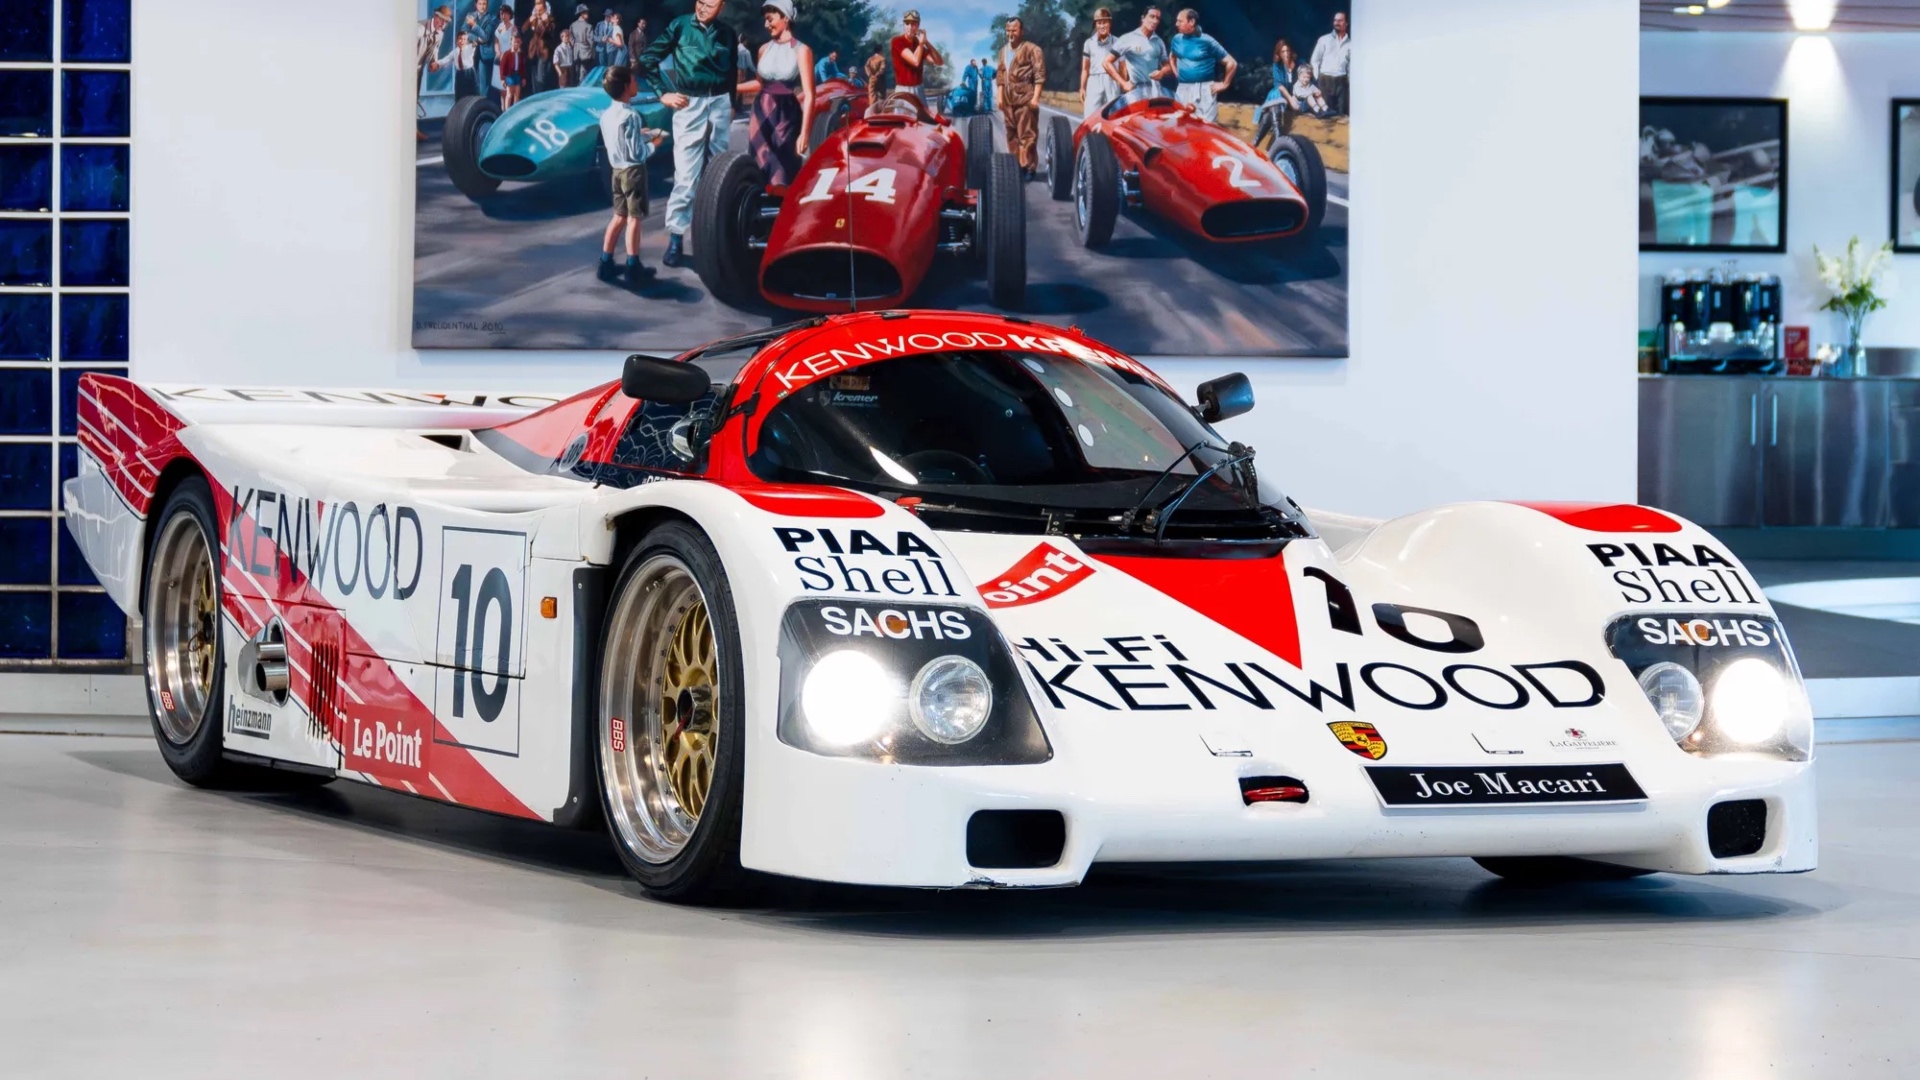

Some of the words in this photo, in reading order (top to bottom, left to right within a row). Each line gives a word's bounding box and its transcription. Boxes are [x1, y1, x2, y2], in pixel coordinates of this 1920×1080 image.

[524, 119, 569, 150] 18
[798, 167, 897, 204] 14
[1210, 155, 1261, 188] 2
[774, 332, 1008, 390] KENWOOD
[833, 391, 879, 402] kremer
[225, 486, 423, 600] KENWOOD
[773, 527, 942, 558] PIAA
[1585, 543, 1736, 568] PIAA
[794, 556, 961, 597] Shell
[1613, 568, 1761, 604] Shell
[820, 606, 972, 640] SACHS
[1643, 617, 1770, 648] SACHS
[450, 563, 513, 723] 10
[161, 691, 174, 710] BBS
[1030, 661, 1606, 712] KENWOOD
[227, 695, 272, 740] heinzmann
[352, 719, 374, 757] Le
[378, 722, 422, 769] Point
[611, 719, 625, 751] BBS
[1409, 774, 1473, 798] Joe
[1473, 773, 1606, 794] Macari
